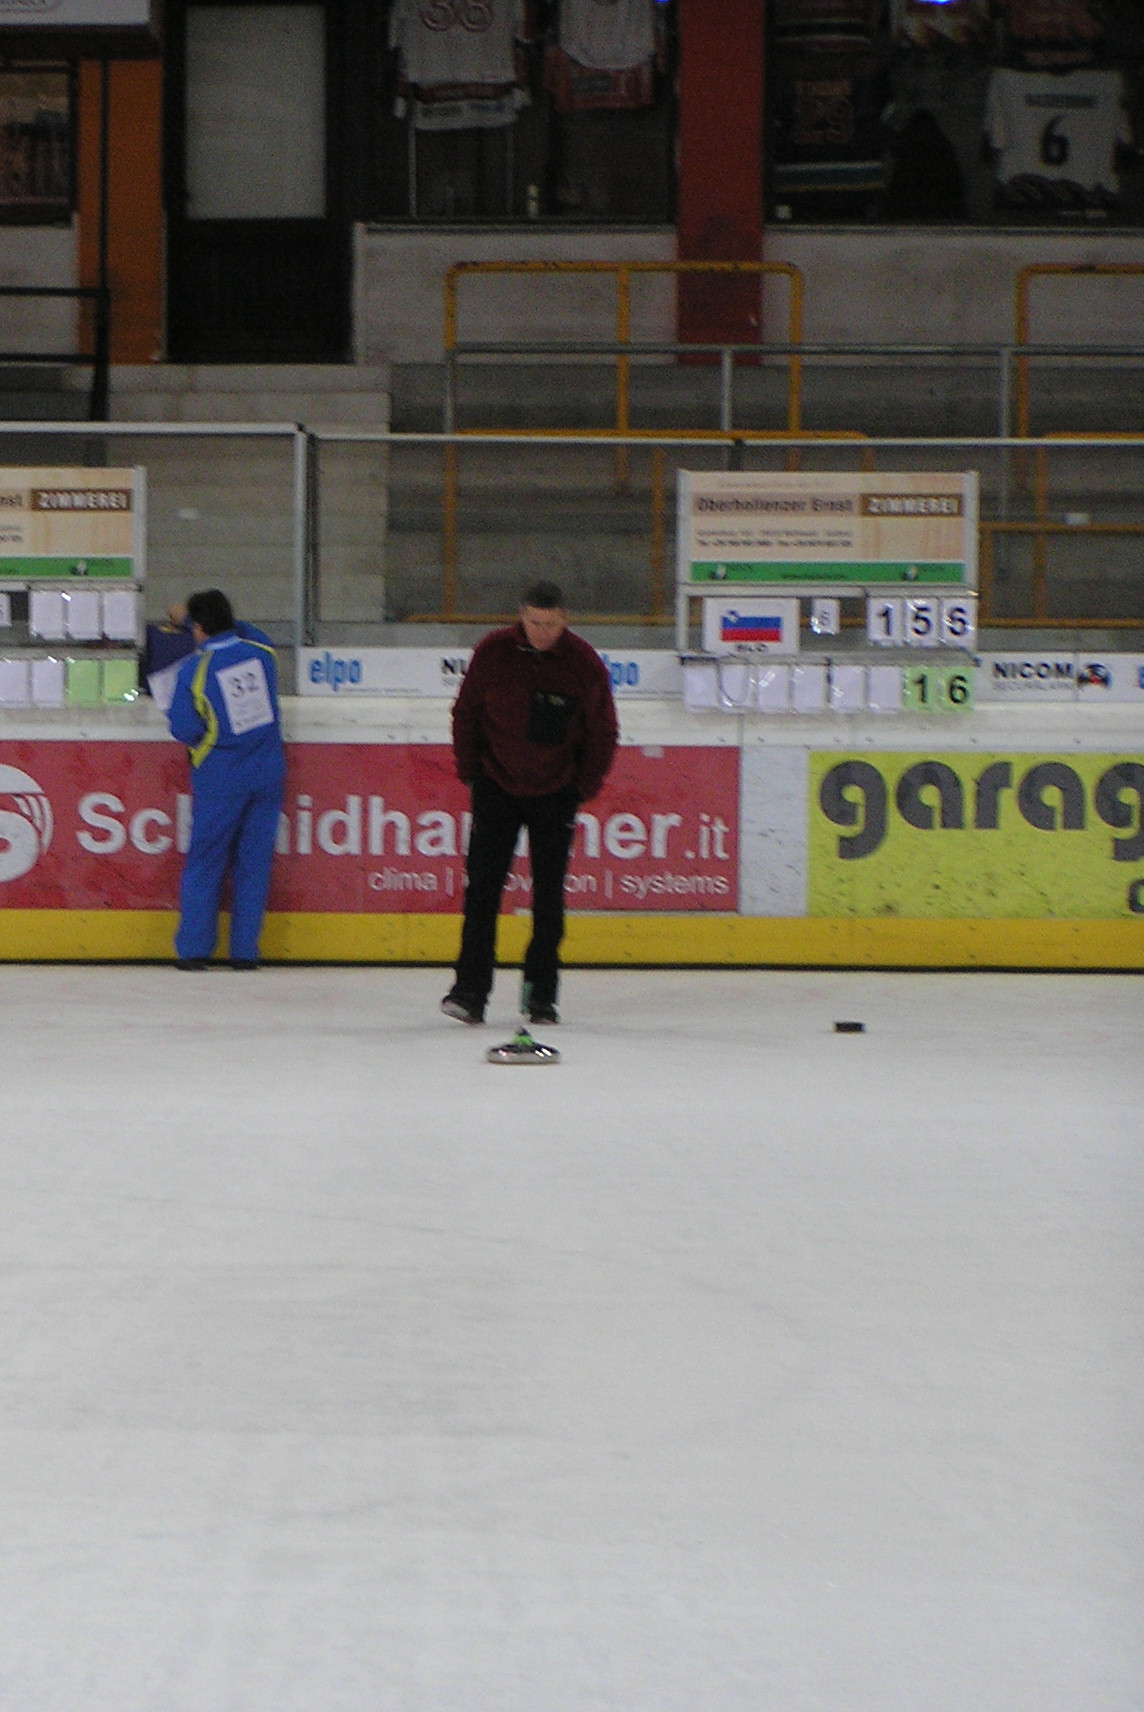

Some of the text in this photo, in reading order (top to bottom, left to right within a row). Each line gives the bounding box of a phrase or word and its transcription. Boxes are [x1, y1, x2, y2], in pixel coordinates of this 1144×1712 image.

[1041, 113, 1071, 167] 6
[39, 492, 129, 508] ZIMMEREI
[811, 497, 853, 514] Ernst
[867, 497, 959, 514] ZIMMEREI
[310, 651, 363, 692] elpo
[993, 661, 1074, 679] NICOM
[912, 673, 972, 705] 16
[367, 867, 438, 893] clima
[620, 871, 730, 900] systems
